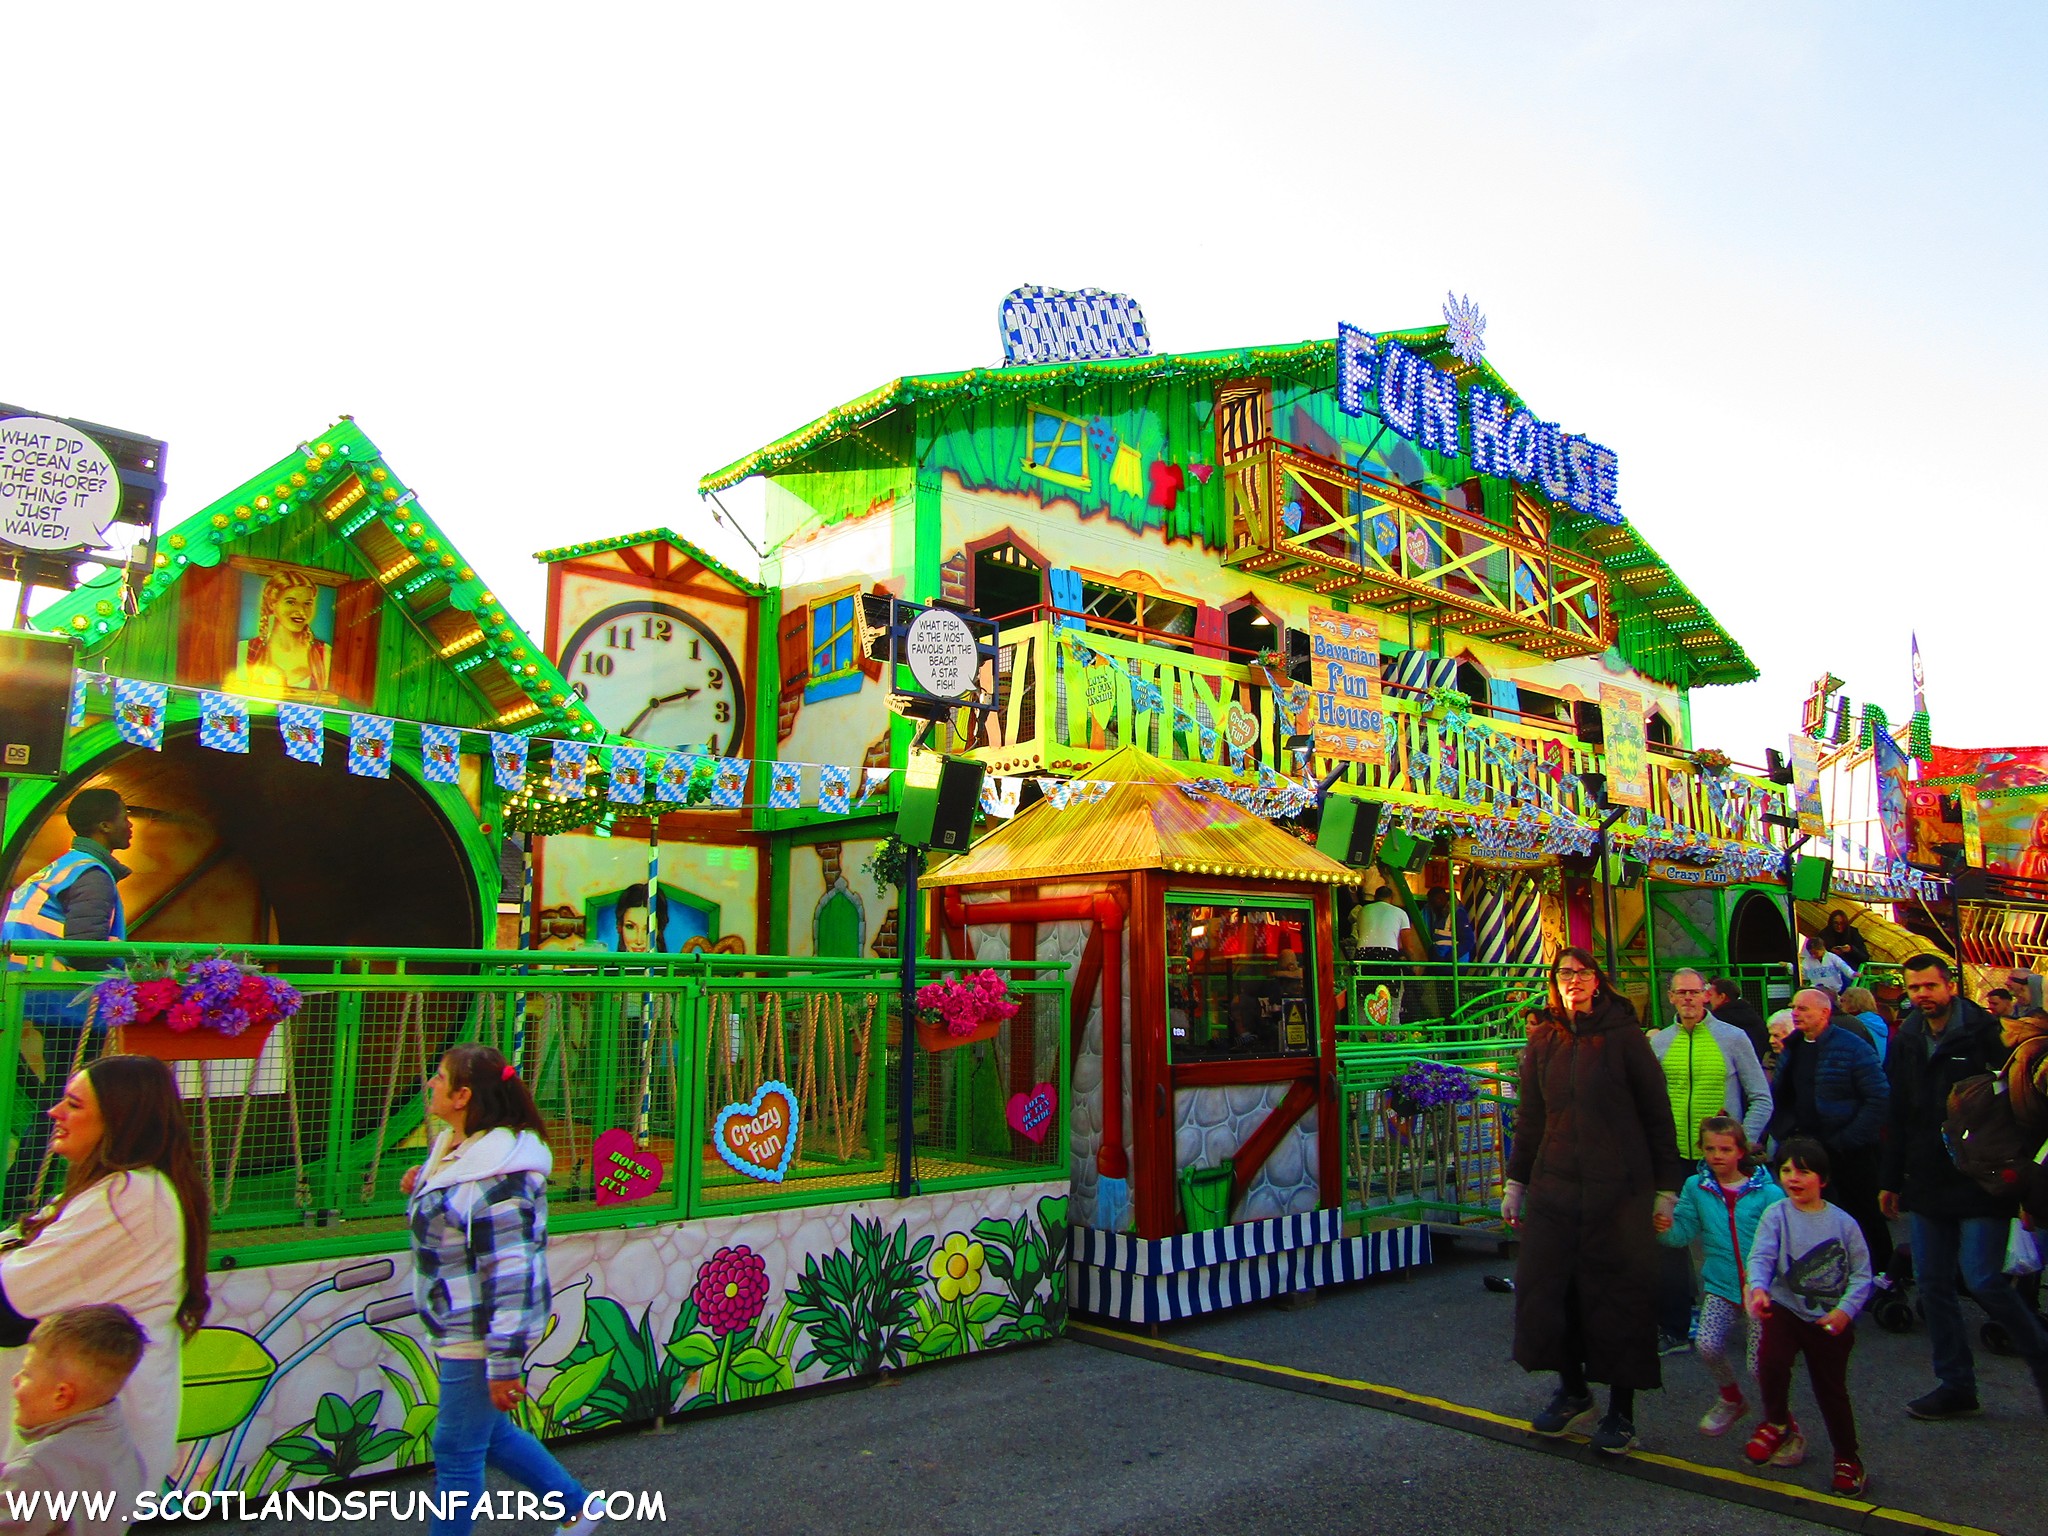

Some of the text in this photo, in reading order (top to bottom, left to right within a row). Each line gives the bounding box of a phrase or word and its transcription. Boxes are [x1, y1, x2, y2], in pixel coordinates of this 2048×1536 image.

[1012, 299, 1138, 357] BAVARIAN
[1337, 321, 1625, 525] FUN HOUSE
[2, 429, 84, 454] WHAT DID
[12, 449, 71, 471] OCEAN
[76, 459, 110, 476] SAY
[2, 465, 108, 492] THE SHORE?
[0, 481, 89, 508] OTHING IT
[16, 503, 62, 521] JUST
[5, 518, 70, 540] WAVED!
[642, 617, 673, 642] 12
[920, 620, 960, 631] WHAT FISH
[606, 625, 636, 651] 11
[917, 632, 964, 643] IS THE MOST
[688, 639, 702, 661] 1
[912, 644, 972, 655] FAMOUS AT THE
[1314, 634, 1378, 667] Bavarian
[582, 651, 614, 676] 10
[929, 656, 957, 666] BEACH?
[708, 668, 723, 690] 2
[931, 668, 959, 678] A STAR
[1327, 661, 1369, 699] Fun
[937, 680, 956, 690] FISH!
[715, 701, 730, 723] 3
[1317, 692, 1382, 733] House
[1230, 712, 1251, 736] Crazy
[1231, 726, 1244, 743] Fun
[8, 747, 26, 758] DS
[1470, 844, 1540, 859] Enjoy the show
[1666, 865, 1727, 883] Crazy Fun
[731, 1106, 782, 1146] Crazy
[1025, 1109, 1050, 1131] INSIDE
[748, 1134, 782, 1164] Fun
[609, 1151, 653, 1180] HOUSE
[613, 1169, 633, 1182] OF
[600, 1176, 629, 1196] FUN
